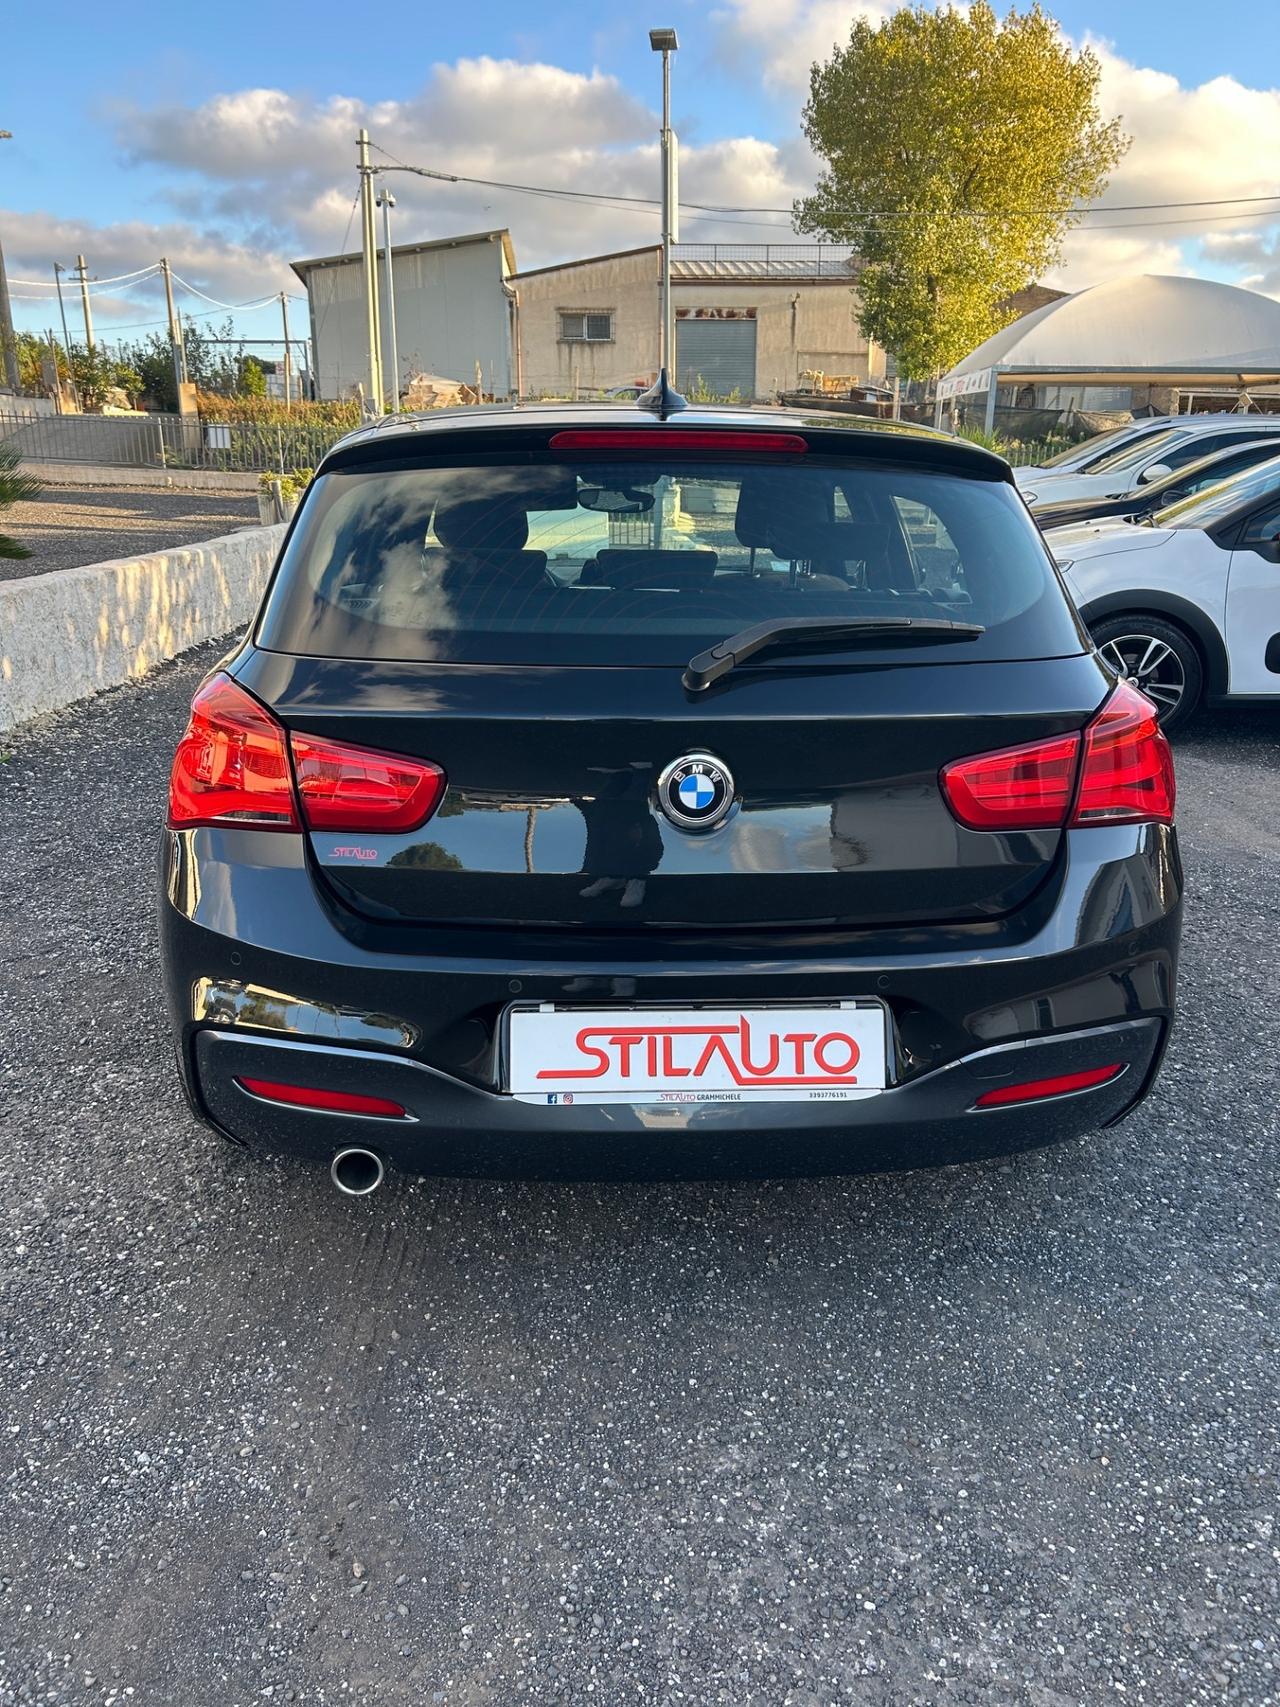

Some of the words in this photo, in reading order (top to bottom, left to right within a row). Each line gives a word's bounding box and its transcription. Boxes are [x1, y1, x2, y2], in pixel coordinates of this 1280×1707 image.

[673, 764, 722, 783] BMW
[328, 846, 378, 860] STILAUTO
[536, 1014, 861, 1086] STILAUTO
[656, 1093, 696, 1102] STILAUTO
[697, 1093, 742, 1101] GRAMMICHELE
